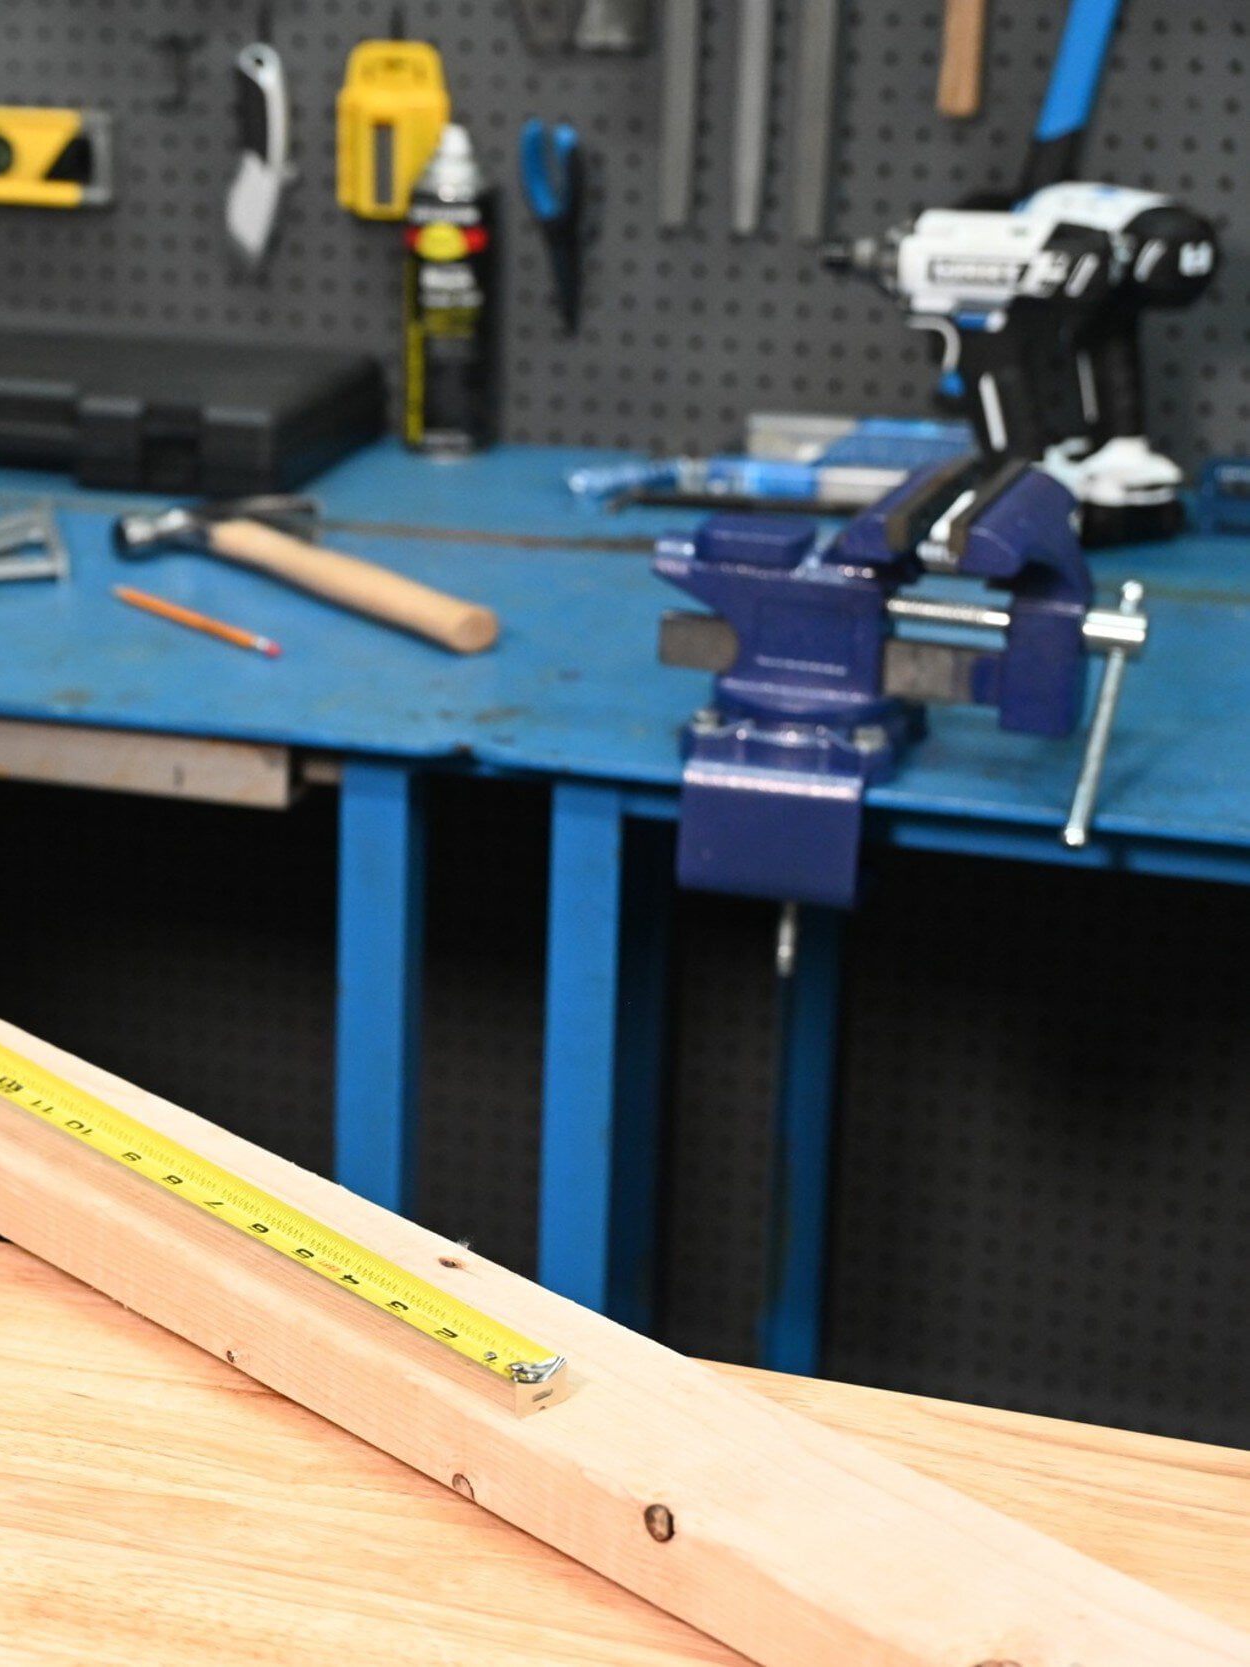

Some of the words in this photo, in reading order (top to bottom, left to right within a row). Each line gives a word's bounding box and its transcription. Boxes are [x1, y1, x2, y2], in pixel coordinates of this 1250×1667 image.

[64, 1119, 93, 1136] 10
[121, 1151, 142, 1162] 9
[162, 1174, 184, 1185] 8
[203, 1201, 224, 1210] 7
[248, 1223, 269, 1235] 6
[295, 1248, 315, 1260] 5
[339, 1274, 360, 1285] 4
[385, 1300, 409, 1312] 3
[434, 1327, 458, 1339] 2
